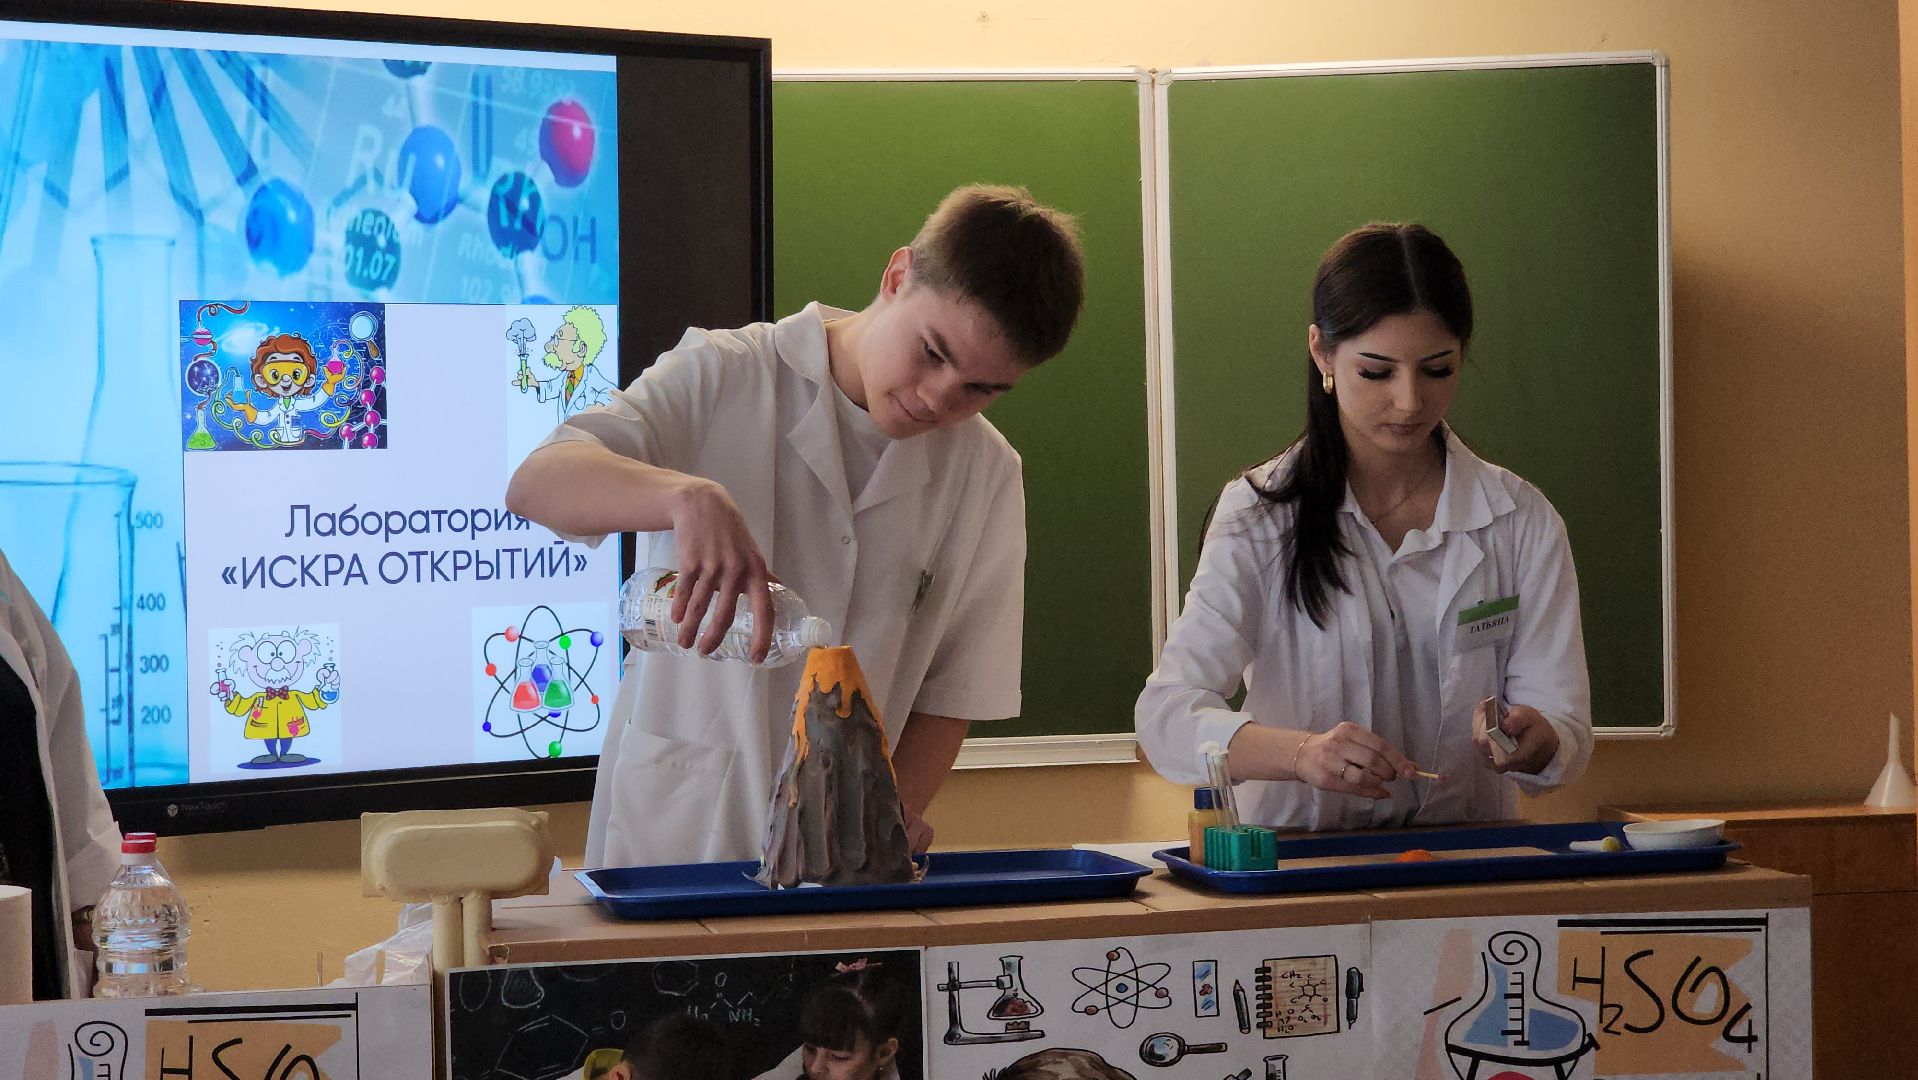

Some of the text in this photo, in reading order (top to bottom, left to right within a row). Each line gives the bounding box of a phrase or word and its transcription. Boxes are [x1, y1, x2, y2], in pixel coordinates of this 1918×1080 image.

[542, 214, 597, 264] OH
[134, 510, 164, 529] 500
[284, 503, 531, 543] Лаборатория
[221, 540, 588, 590] «ИСКРА ОТКРЫТИЙ»
[136, 592, 166, 611] 400
[1469, 615, 1510, 634] ТАТЬЯНА
[139, 654, 170, 674] 300
[140, 704, 172, 725] 200
